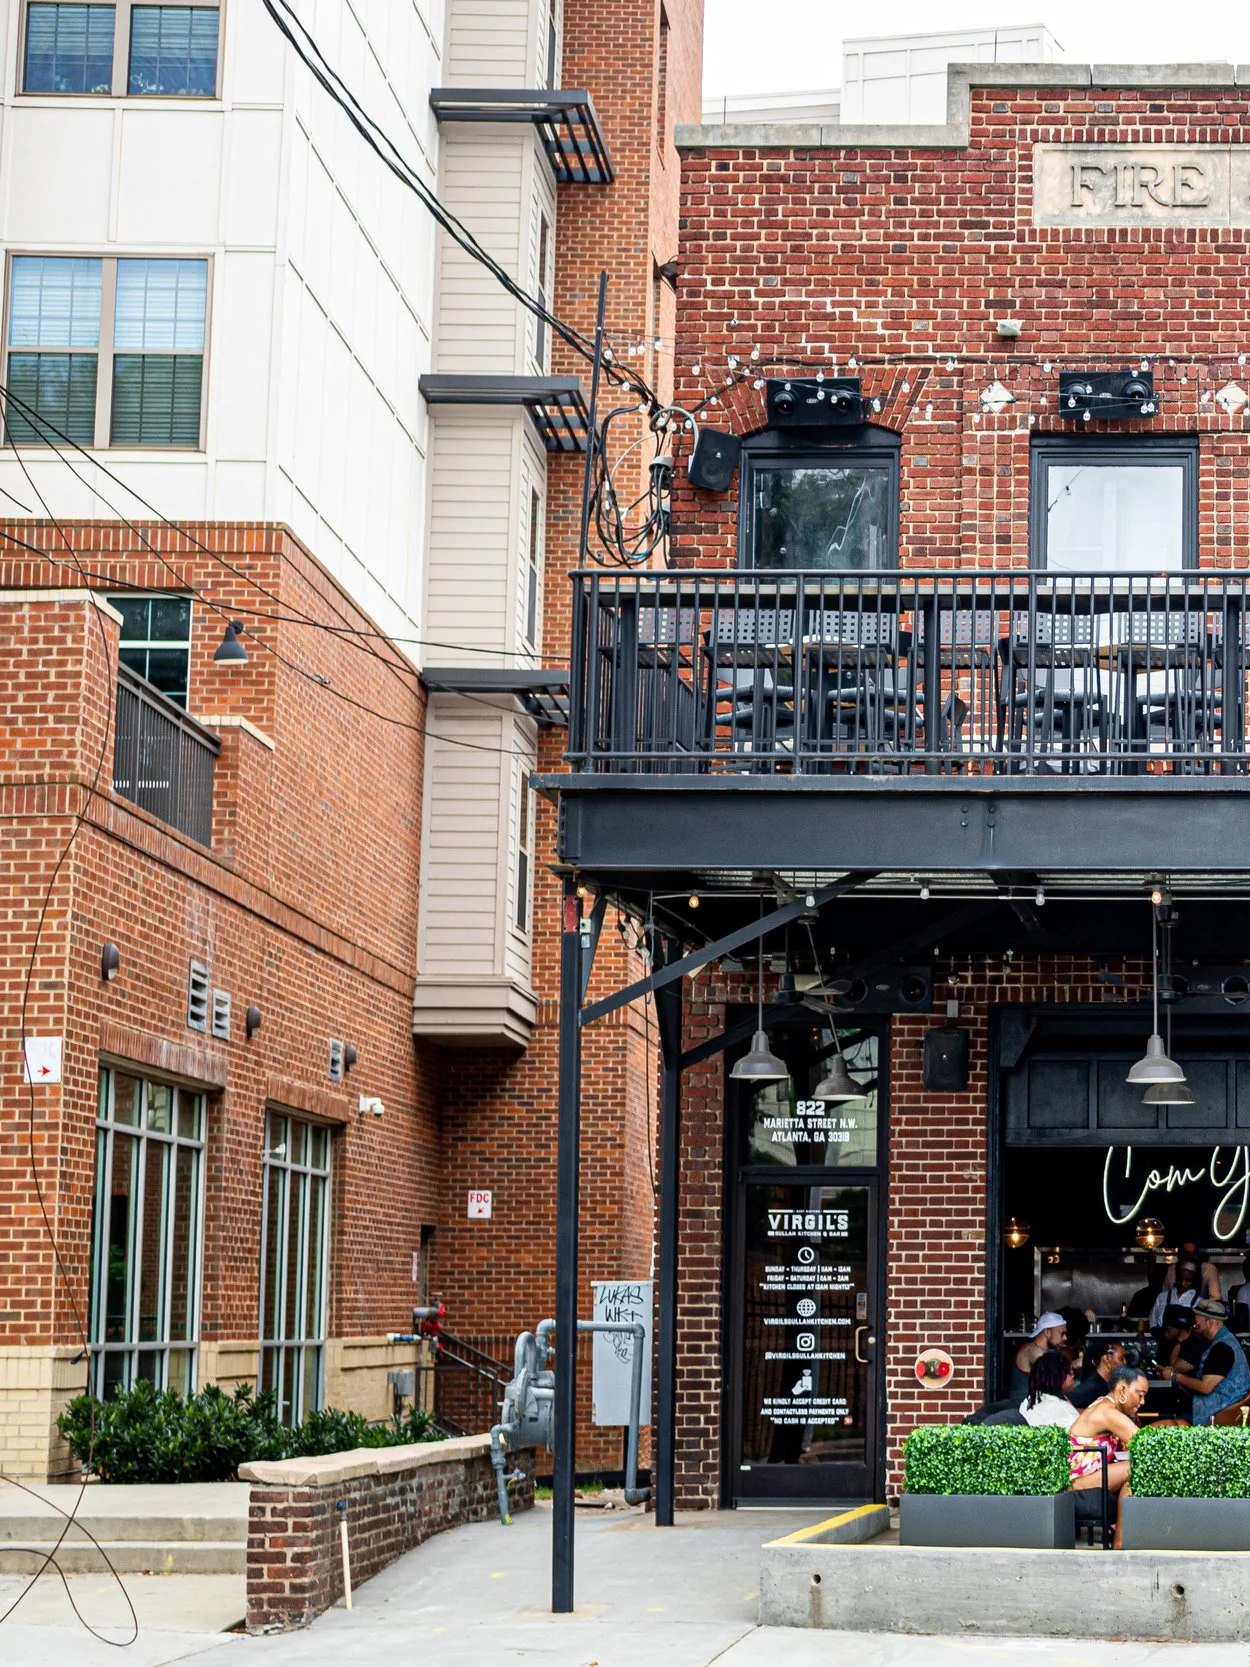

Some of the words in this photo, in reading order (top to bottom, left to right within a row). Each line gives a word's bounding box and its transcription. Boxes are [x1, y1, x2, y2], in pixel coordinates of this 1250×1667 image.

[1070, 162, 1208, 209] FIRE
[796, 1100, 825, 1115] 822
[764, 1118, 804, 1129] MARIETTA
[807, 1118, 837, 1129] STREET
[840, 1118, 858, 1129] N.W.
[772, 1131, 811, 1142] ATLANTA,
[814, 1131, 825, 1142] GA
[470, 1193, 489, 1203] FDC
[768, 1214, 849, 1230] VIRGIL'S
